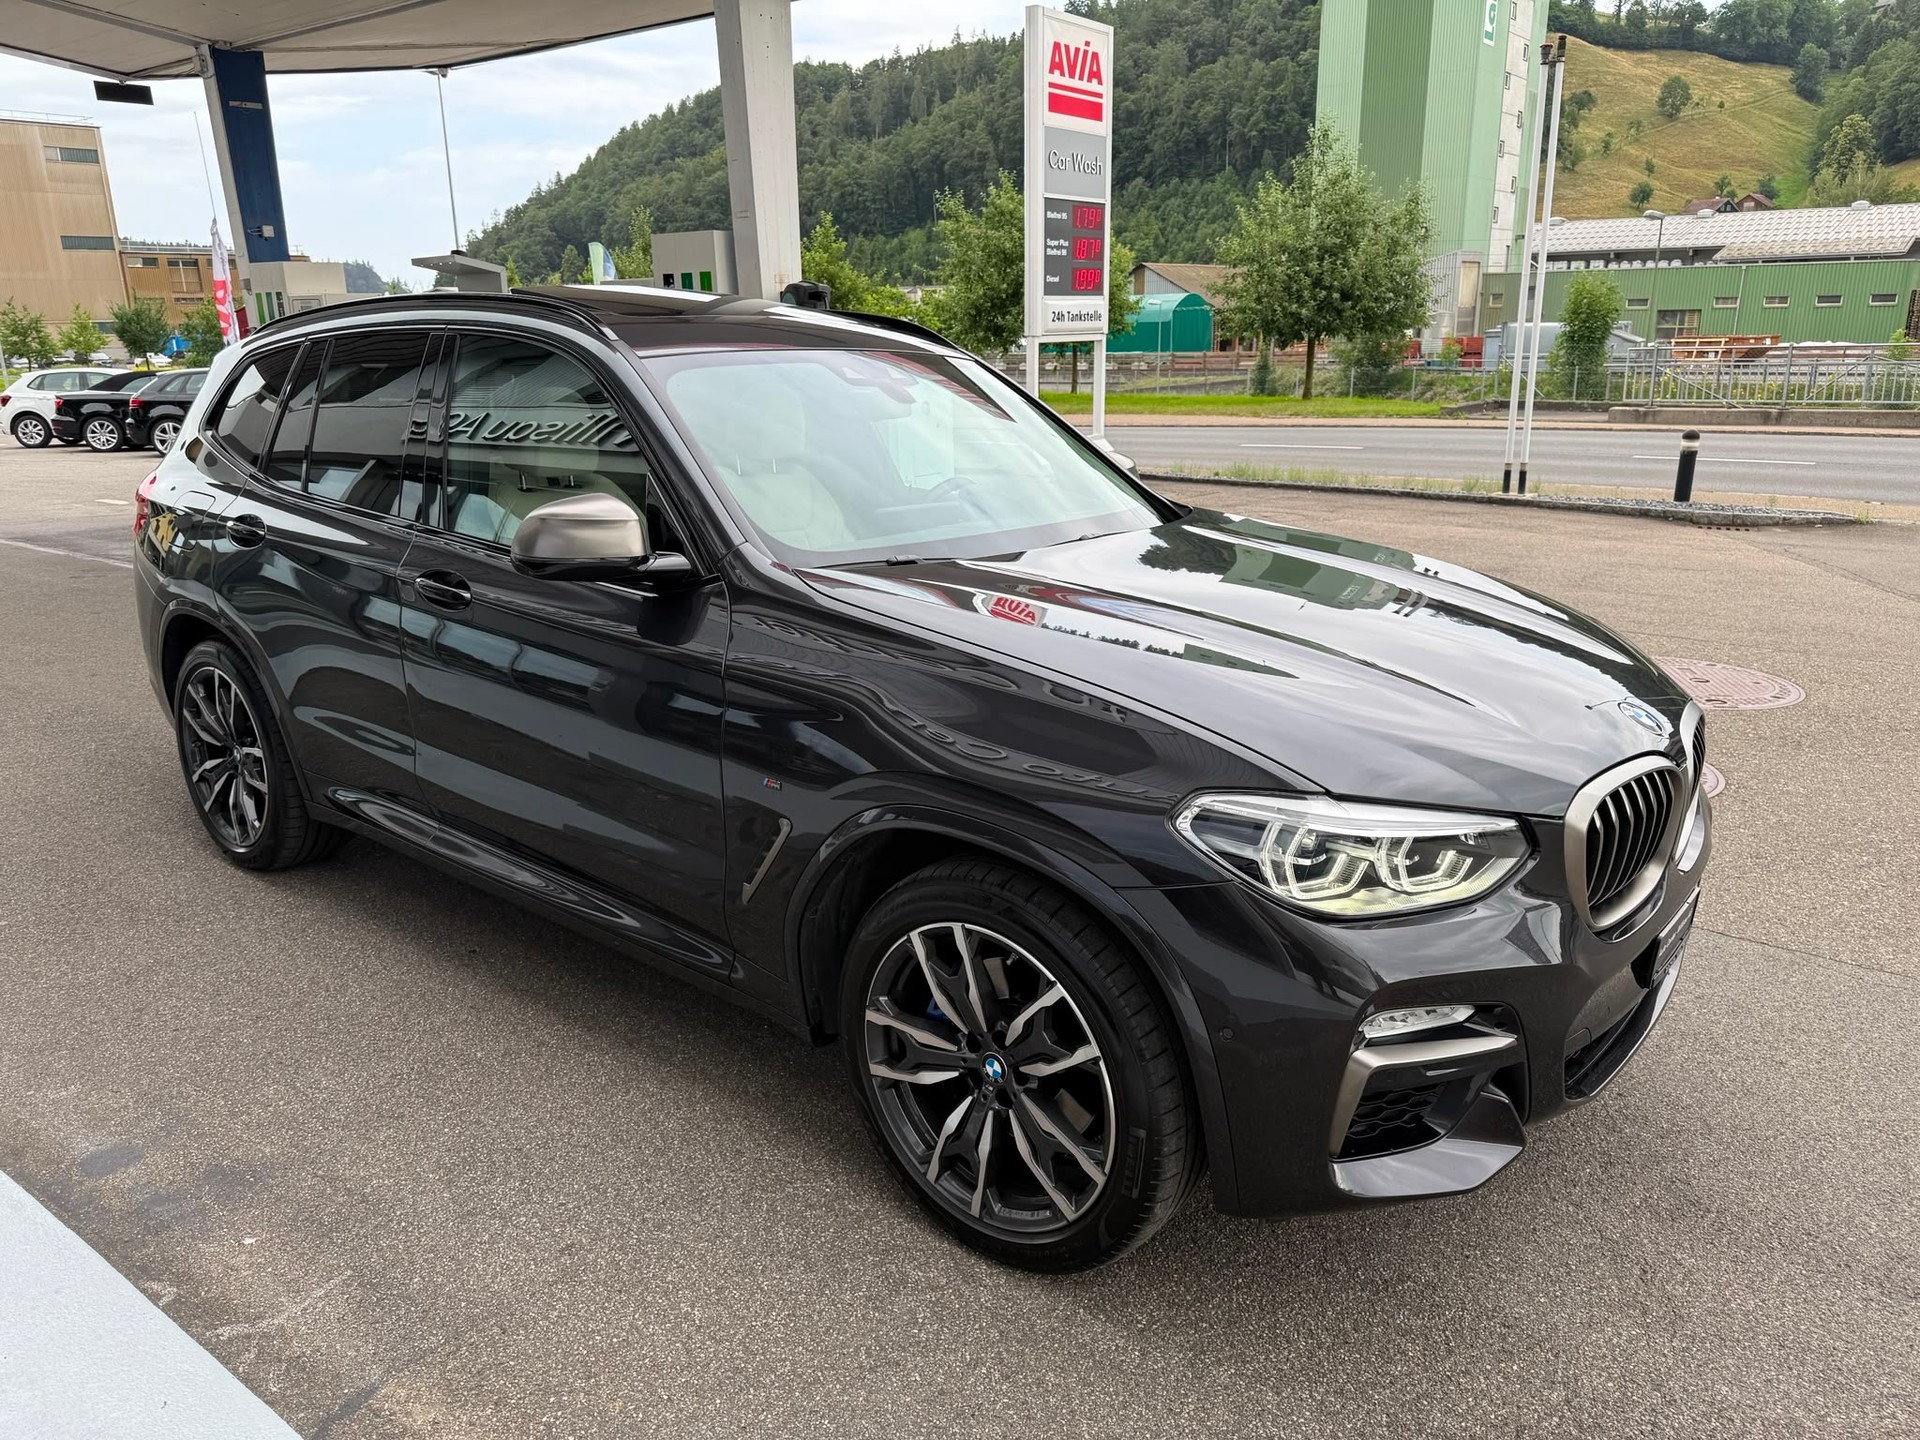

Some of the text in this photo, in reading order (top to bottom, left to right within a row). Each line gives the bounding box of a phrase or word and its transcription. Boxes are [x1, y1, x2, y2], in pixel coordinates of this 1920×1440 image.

[1484, 0, 1497, 42] La
[1048, 40, 1103, 86] AVIA
[1049, 149, 1103, 176] Car Wash
[1046, 238, 1069, 247] Super Plus
[1046, 275, 1060, 283] Diesel
[1051, 310, 1102, 322] 24h Tankstelle
